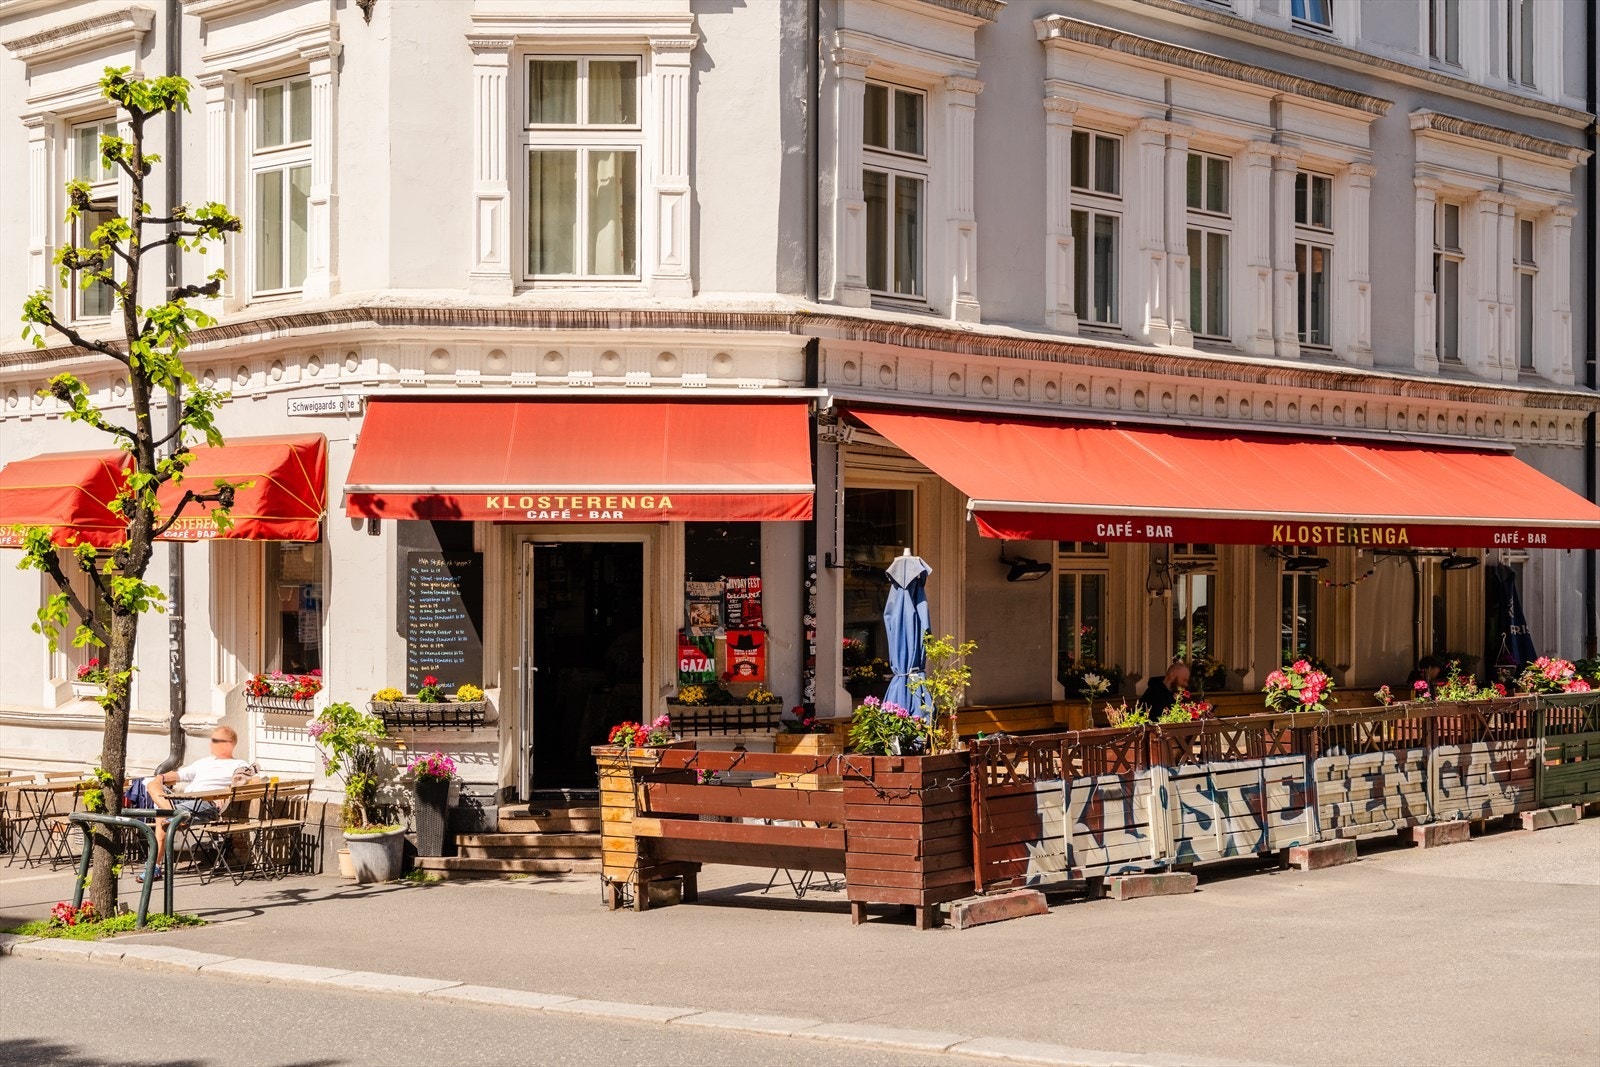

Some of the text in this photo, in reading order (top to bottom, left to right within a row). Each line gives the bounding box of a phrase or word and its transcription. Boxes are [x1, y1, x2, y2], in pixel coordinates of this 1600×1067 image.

[292, 400, 355, 412] Schweigaards gte
[486, 496, 673, 509] KLOSTERENGA
[527, 509, 571, 519] CAFÉ
[589, 510, 623, 519] BAR
[1096, 520, 1133, 537] CAFÉ
[1146, 525, 1173, 538] BAR
[1272, 525, 1409, 544] KLOSTERENGA
[0, 536, 12, 545] FÉ
[1494, 530, 1519, 544] CAFÉ
[1527, 533, 1548, 544] BAR
[747, 577, 761, 589] FEST
